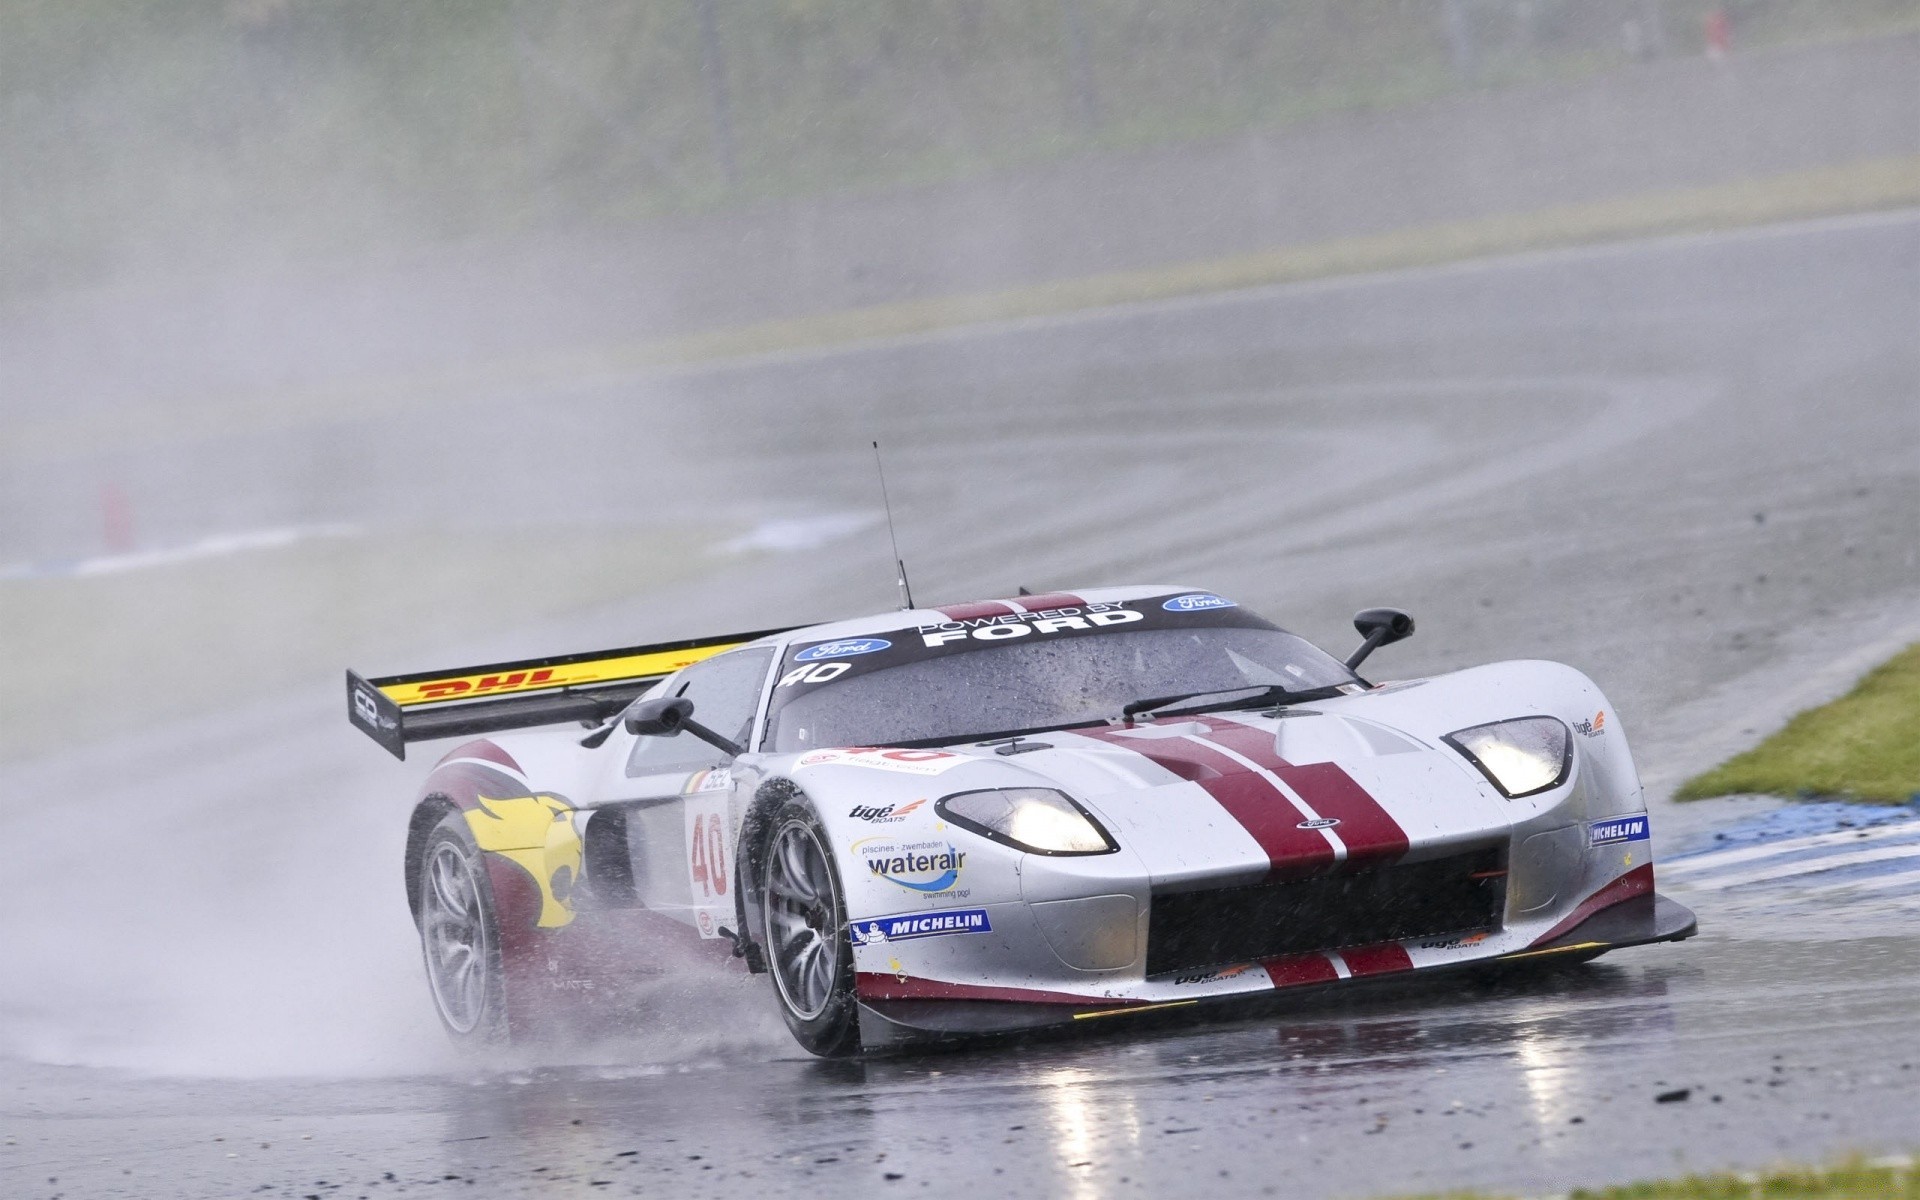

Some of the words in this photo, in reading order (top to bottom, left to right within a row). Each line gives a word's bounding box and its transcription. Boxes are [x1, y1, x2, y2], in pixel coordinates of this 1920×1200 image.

[1178, 596, 1225, 609] Ford
[917, 607, 1082, 634] POWERED
[1087, 601, 1124, 612] BY
[922, 610, 1144, 648] FORD
[812, 641, 872, 658] Ford
[418, 669, 567, 698] DHL
[776, 663, 852, 688] 40
[849, 803, 895, 821] tigé
[871, 816, 906, 824] BOATS
[1593, 821, 1643, 841] MICHELIN
[692, 813, 727, 898] 40
[862, 844, 895, 855] piscines
[901, 840, 943, 851] zwembaden
[868, 847, 966, 875] waterair
[923, 890, 956, 899] swimming
[957, 888, 971, 898] pool
[890, 914, 983, 935] MICHELIN
